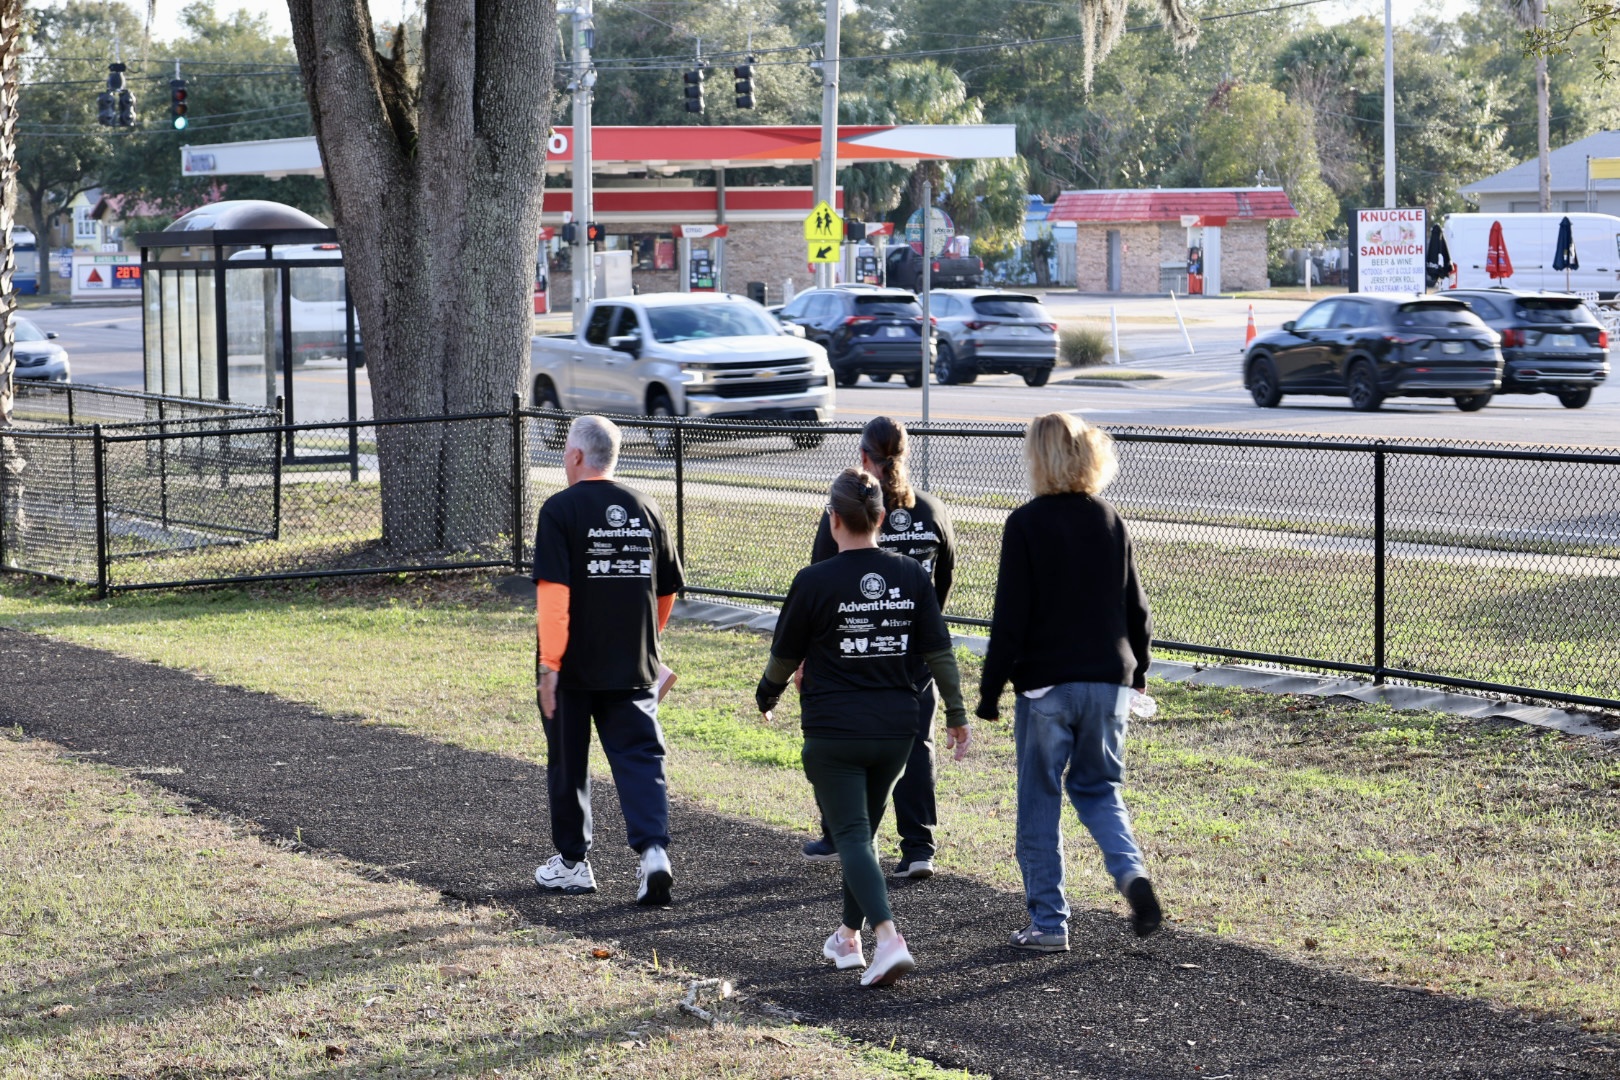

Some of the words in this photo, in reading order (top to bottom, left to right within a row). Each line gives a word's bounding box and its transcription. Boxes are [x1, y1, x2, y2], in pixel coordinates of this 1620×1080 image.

[1360, 211, 1423, 222] KNUCKLE
[1361, 244, 1423, 256] SANDWICH
[1371, 258, 1389, 266] BEER
[1390, 258, 1396, 266] &
[1396, 257, 1413, 266] WINE
[876, 531, 937, 542] dventHealth
